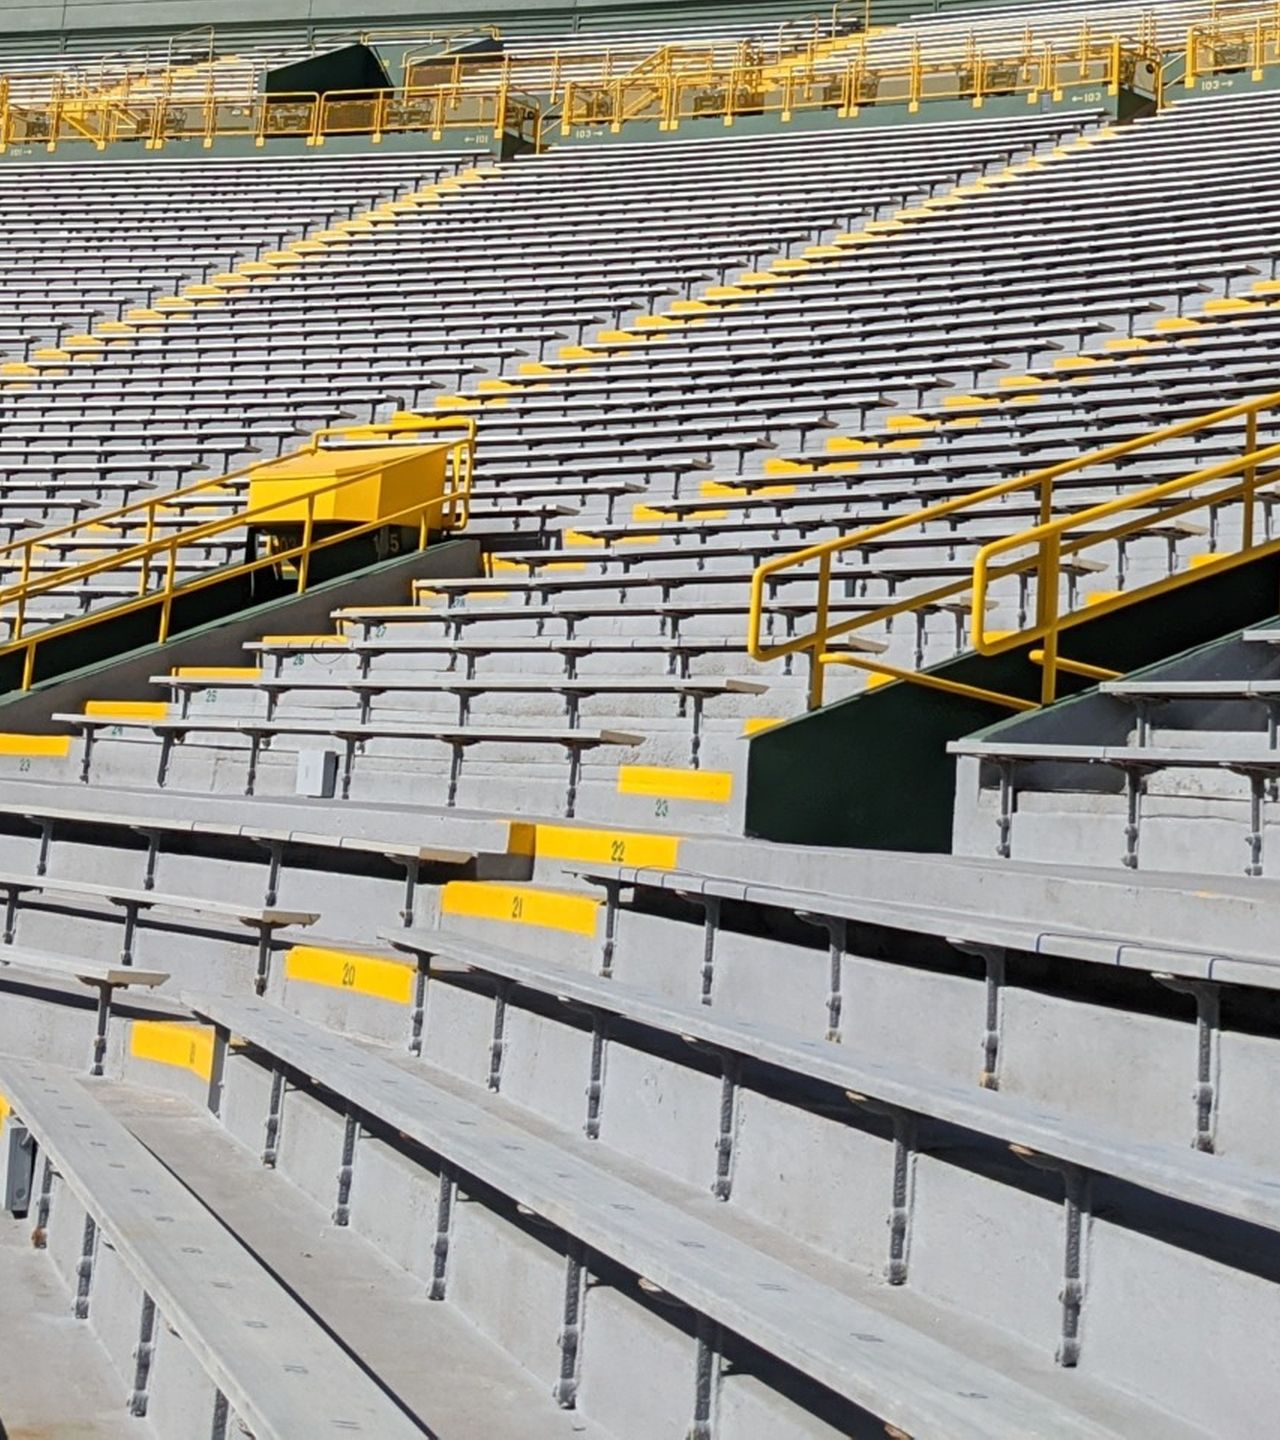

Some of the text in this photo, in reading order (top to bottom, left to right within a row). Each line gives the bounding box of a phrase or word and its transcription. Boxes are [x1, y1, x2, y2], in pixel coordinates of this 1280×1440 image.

[1201, 81, 1220, 91] 103
[1084, 93, 1101, 102] 103
[576, 130, 591, 139] 103
[19, 758, 31, 773] 23
[654, 798, 668, 817] 23
[610, 840, 625, 862] 22
[511, 896, 522, 919] 21
[342, 962, 356, 986] 20
